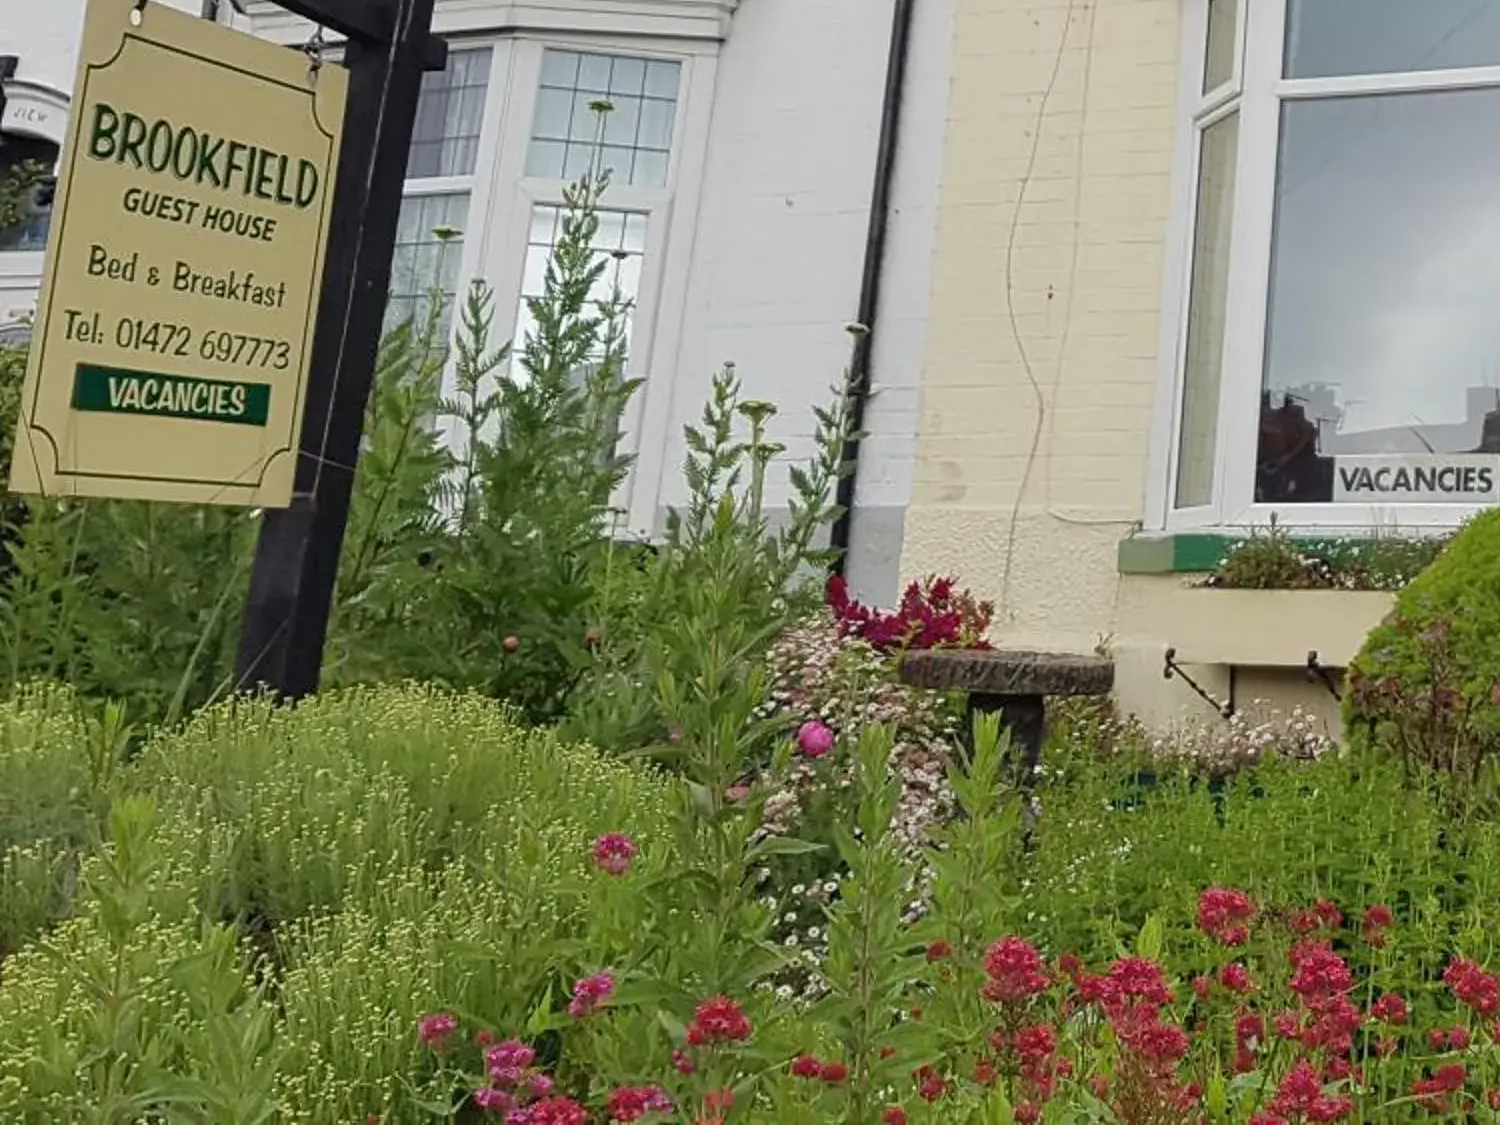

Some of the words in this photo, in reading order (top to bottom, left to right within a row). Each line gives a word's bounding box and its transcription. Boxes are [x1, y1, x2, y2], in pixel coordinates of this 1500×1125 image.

[87, 103, 319, 209] BROOKFIELD
[123, 188, 201, 225] GUEST
[202, 206, 277, 241] HOUSE
[87, 244, 137, 282] Bed
[147, 265, 161, 287] &
[173, 262, 286, 309] Breakfast
[116, 317, 190, 357] 01472
[200, 333, 290, 370] 697773
[107, 377, 246, 416] VACANCIES
[1339, 466, 1493, 493] VACANCIES
